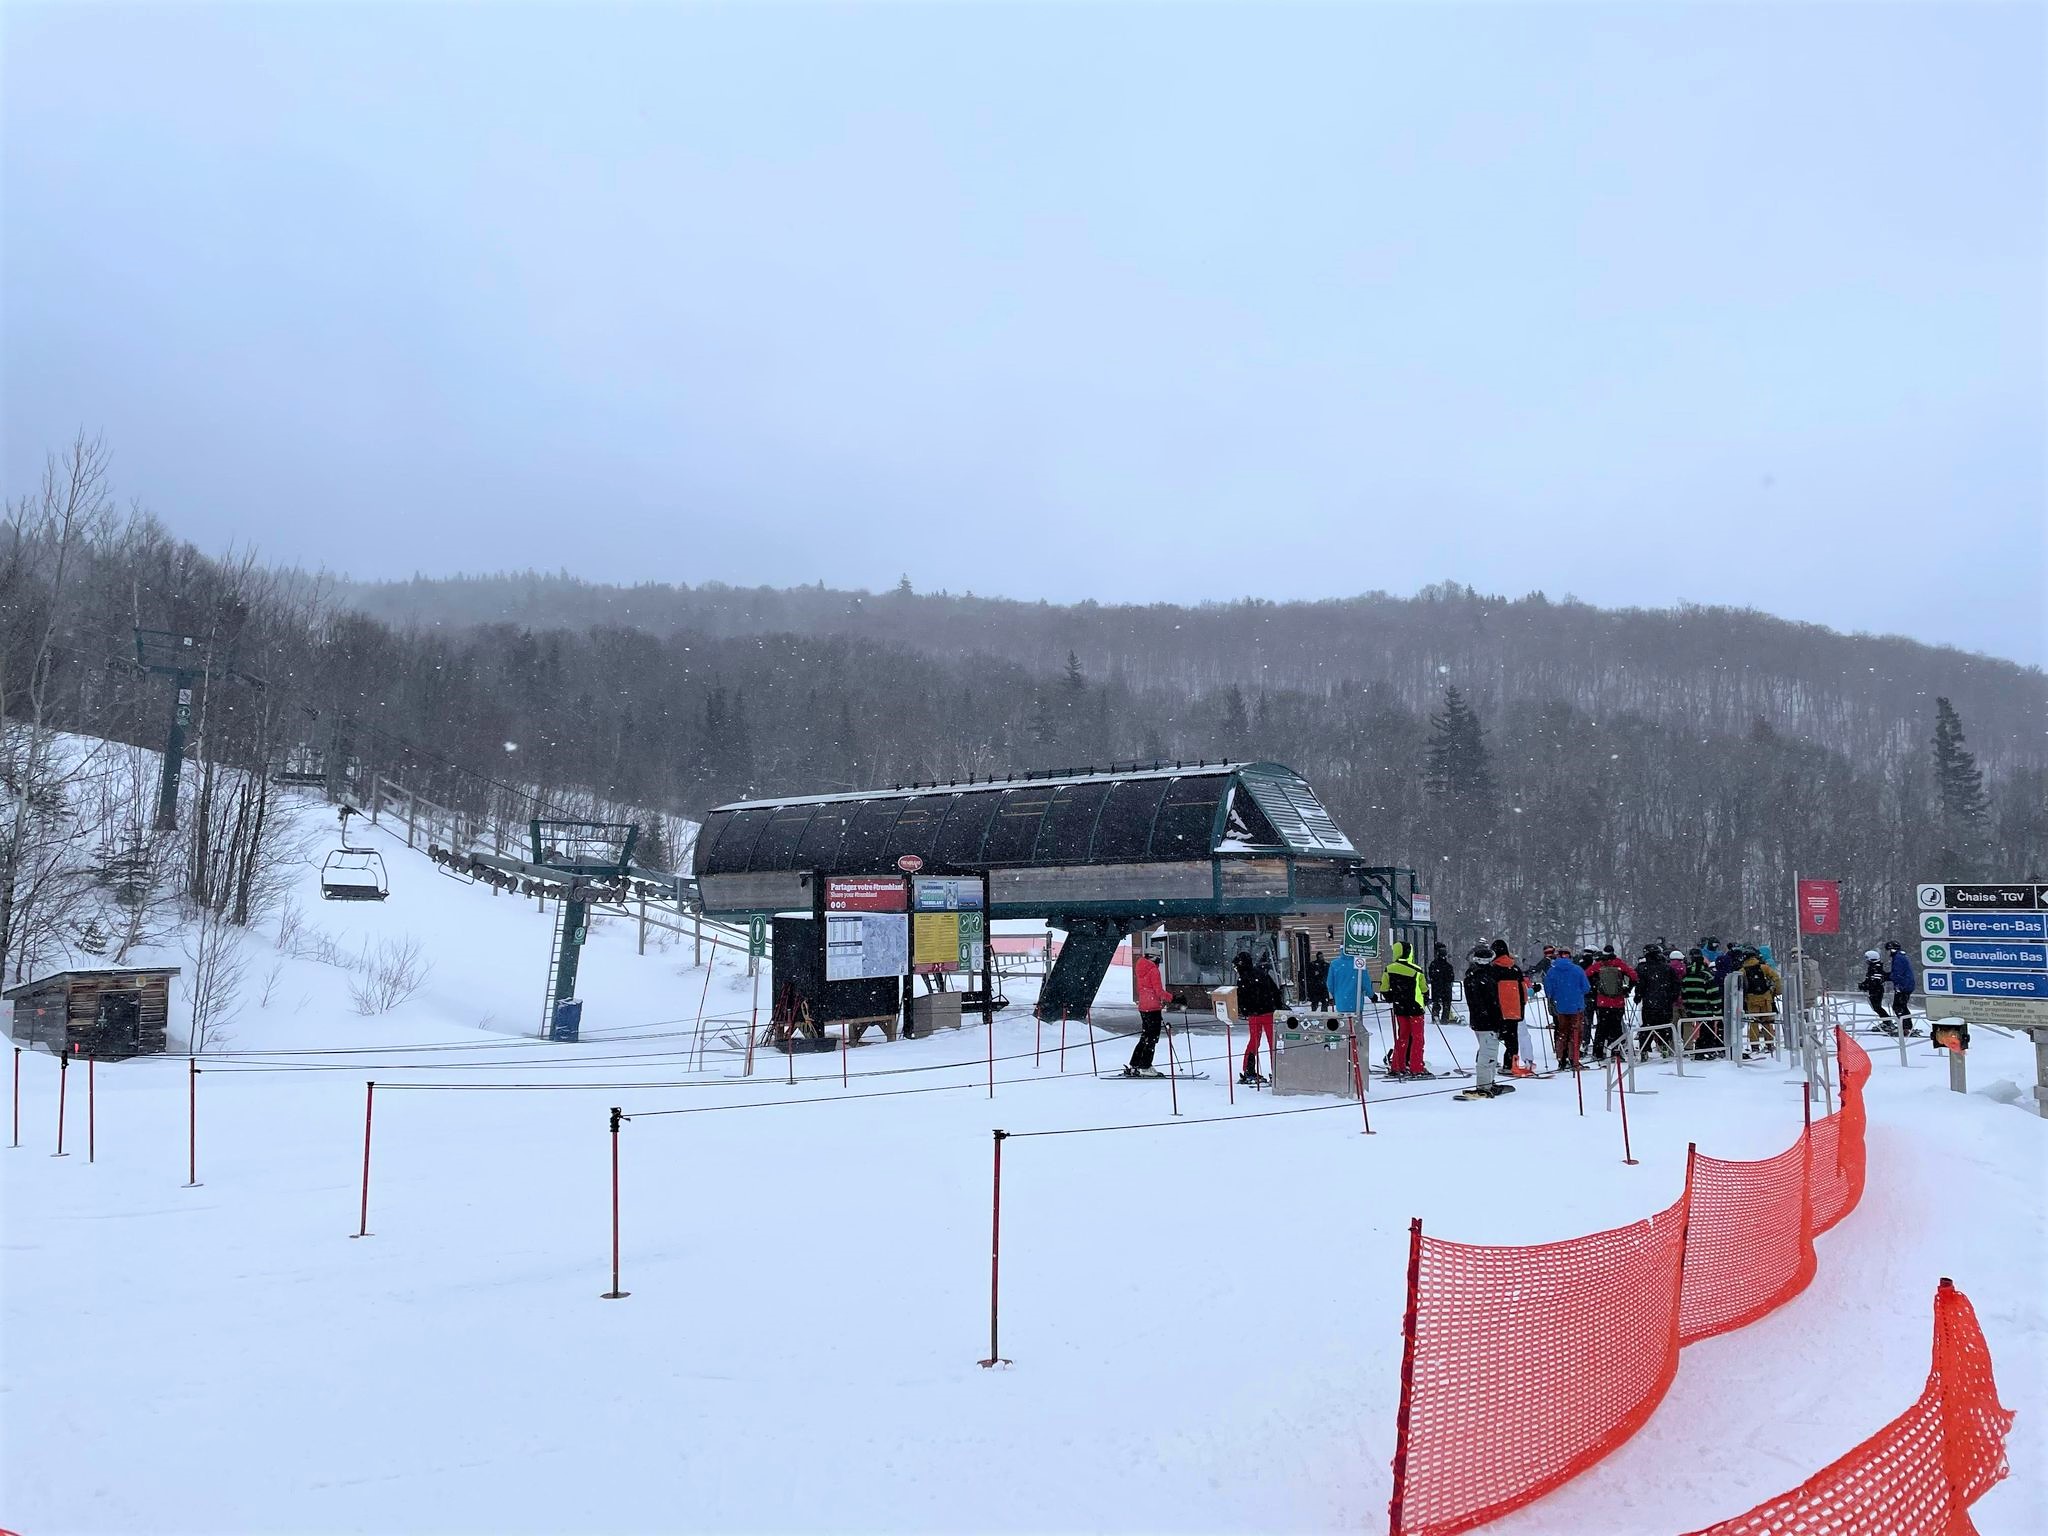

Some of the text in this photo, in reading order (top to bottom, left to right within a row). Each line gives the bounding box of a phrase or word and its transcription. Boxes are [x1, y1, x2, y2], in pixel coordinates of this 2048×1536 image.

[173, 773, 179, 782] 2
[830, 883, 857, 892] Partagez
[873, 883, 904, 891] #tremblant
[1957, 892, 2025, 902] Chaise TGV
[1927, 920, 2042, 932] 31 Bière-en-Bas
[1929, 949, 2043, 962] 32 Beauvallon Bas
[1931, 977, 2036, 991] 20 Desserres
